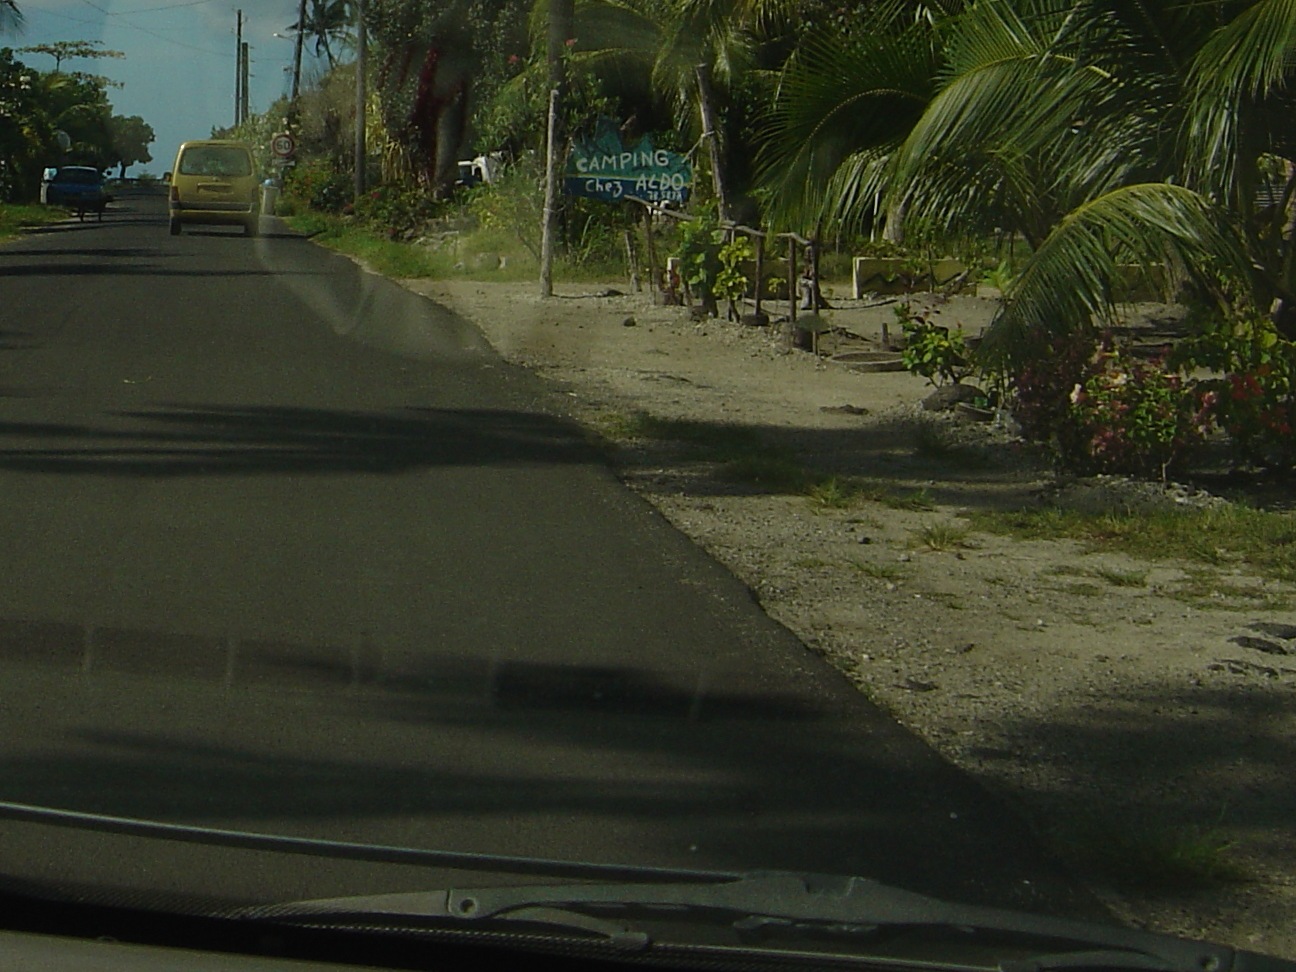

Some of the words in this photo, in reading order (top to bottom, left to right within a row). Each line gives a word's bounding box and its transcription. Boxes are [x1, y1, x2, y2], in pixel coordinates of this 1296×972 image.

[576, 149, 669, 172] CAMPING
[585, 177, 623, 198] Chez
[635, 172, 684, 191] ALDO
